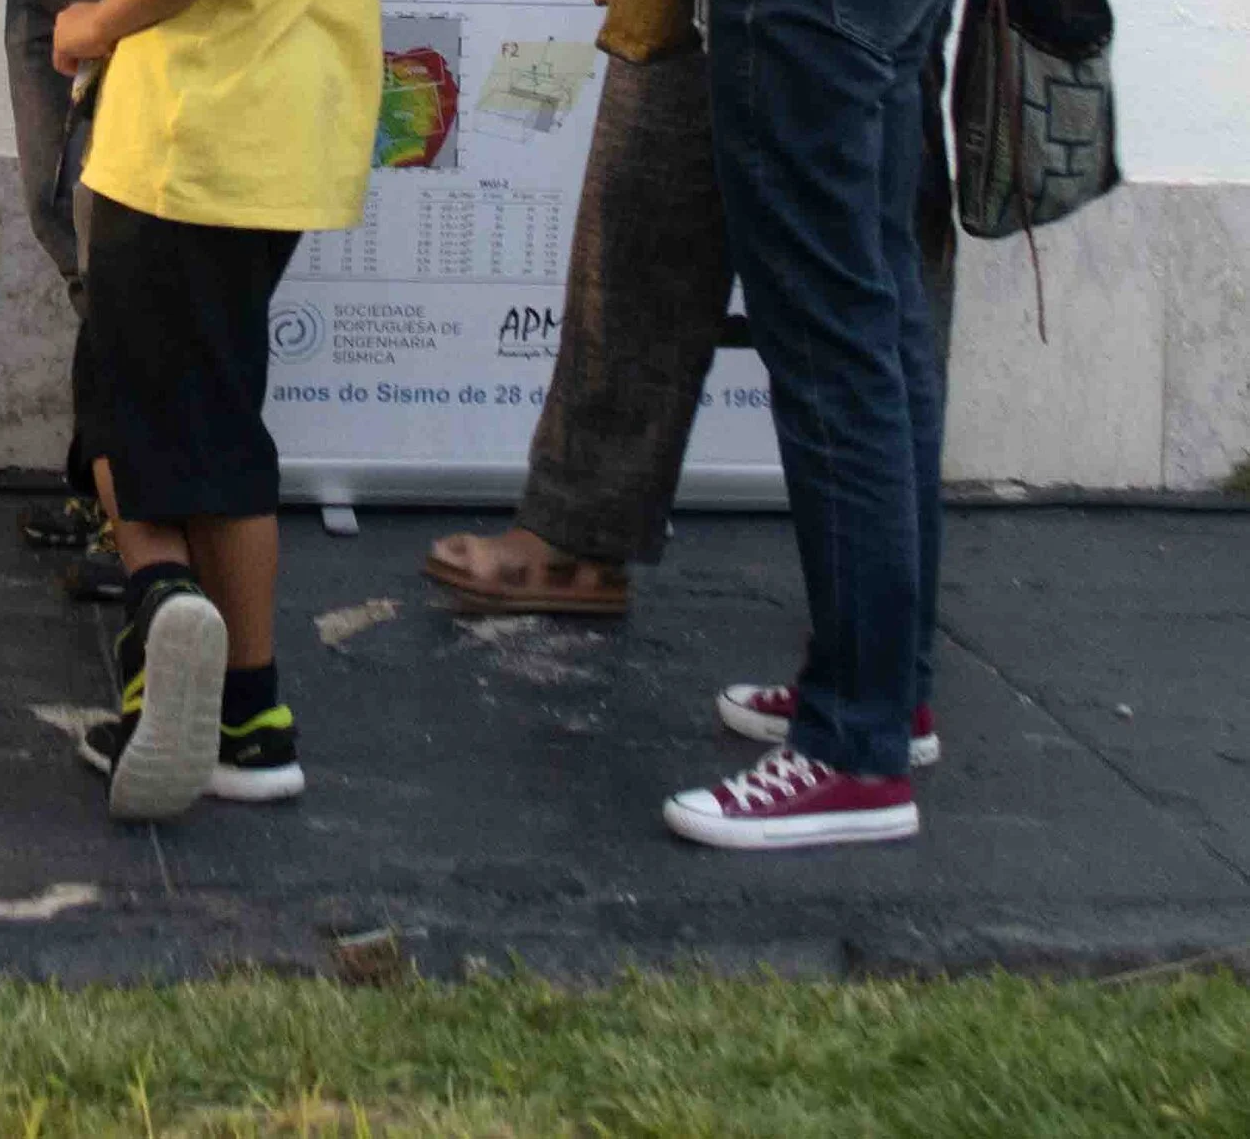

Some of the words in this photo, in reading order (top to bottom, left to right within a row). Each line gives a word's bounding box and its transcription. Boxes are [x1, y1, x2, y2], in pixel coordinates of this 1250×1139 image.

[502, 42, 519, 58] F2
[334, 303, 426, 318] SOCIEDADE
[334, 320, 437, 334] PORTUGUESA
[441, 321, 461, 335] DE
[334, 334, 437, 349] ENGENHARIA
[273, 386, 330, 402] anos
[339, 384, 368, 403] do
[377, 383, 450, 403] Sismo
[459, 385, 487, 403] de
[494, 387, 521, 404] 28
